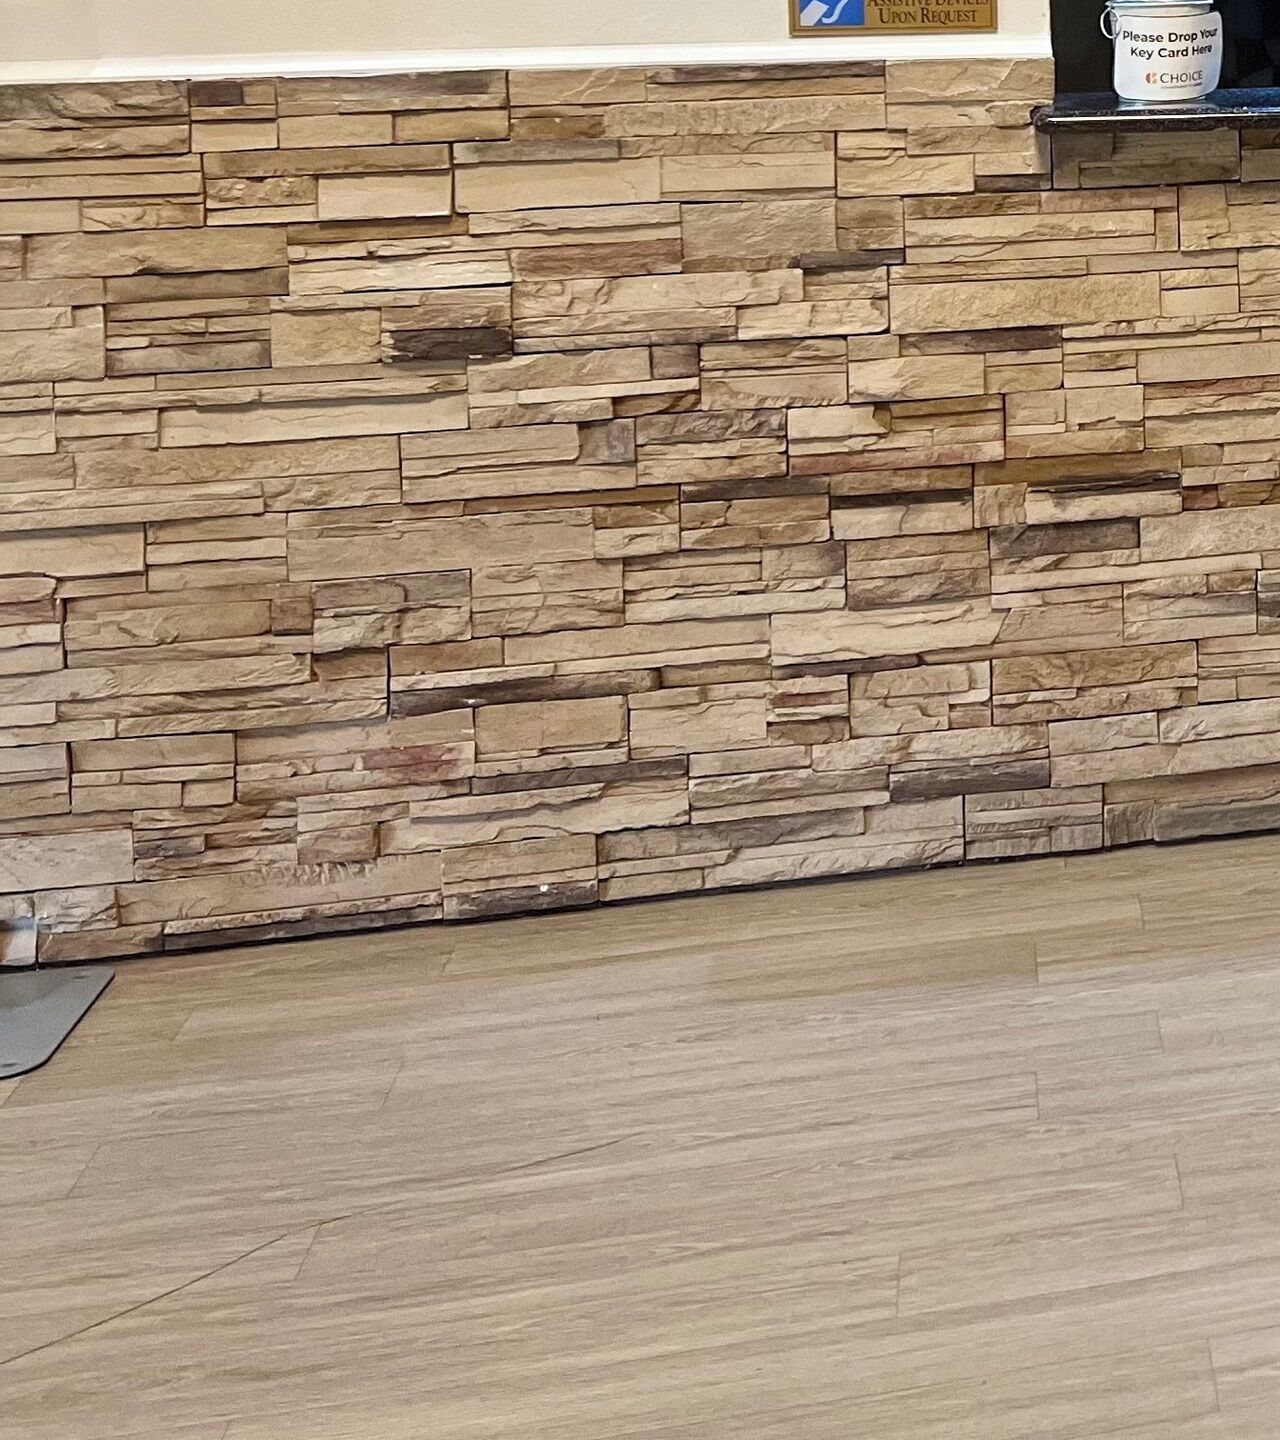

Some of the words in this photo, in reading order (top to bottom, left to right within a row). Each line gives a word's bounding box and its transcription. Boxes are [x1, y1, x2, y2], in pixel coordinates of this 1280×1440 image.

[1122, 30, 1164, 43] Please
[1168, 31, 1198, 44] Drop
[1200, 27, 1218, 40] Your
[1130, 47, 1154, 60] Key
[1158, 47, 1188, 58] Card
[1191, 44, 1213, 56] Here
[1159, 70, 1203, 84] CHOICE
